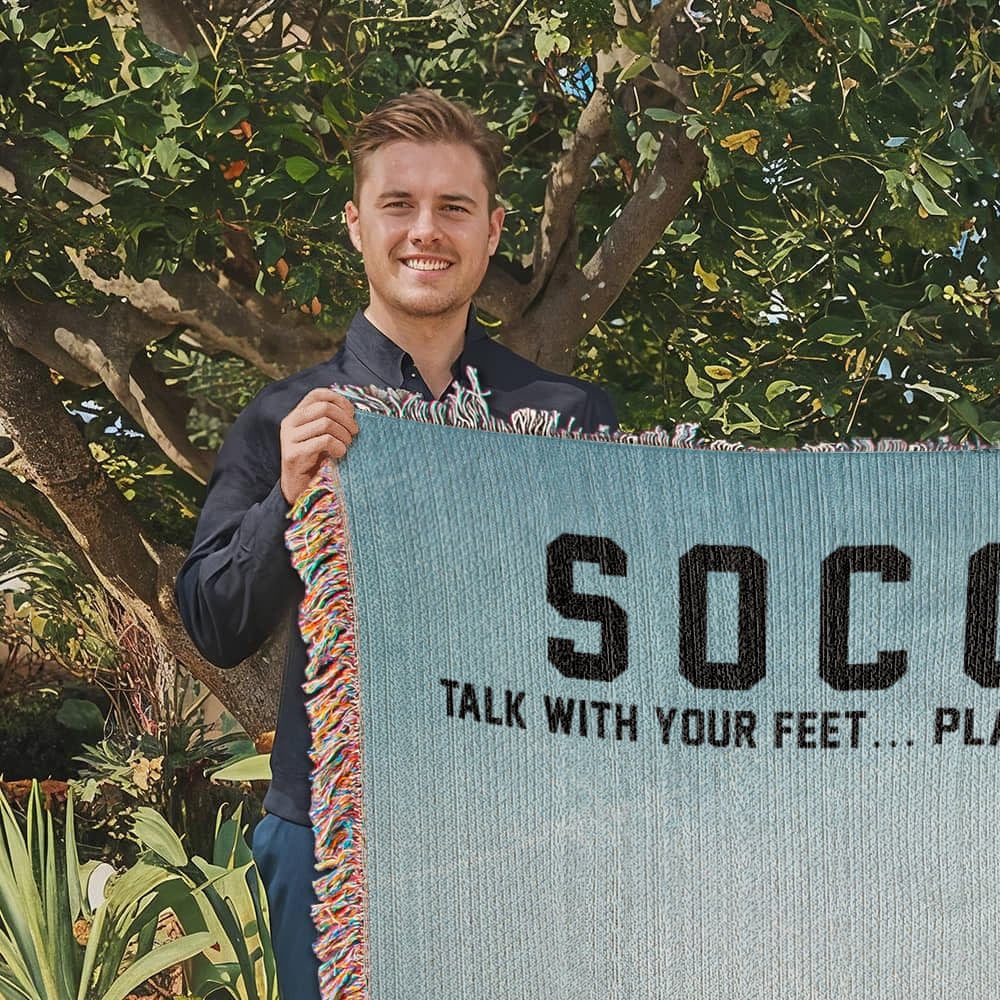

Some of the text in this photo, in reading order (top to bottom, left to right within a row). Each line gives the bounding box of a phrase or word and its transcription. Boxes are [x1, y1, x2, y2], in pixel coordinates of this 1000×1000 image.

[438, 678, 527, 730] TALK
[544, 694, 638, 743] WITH
[654, 706, 757, 749] YOUR
